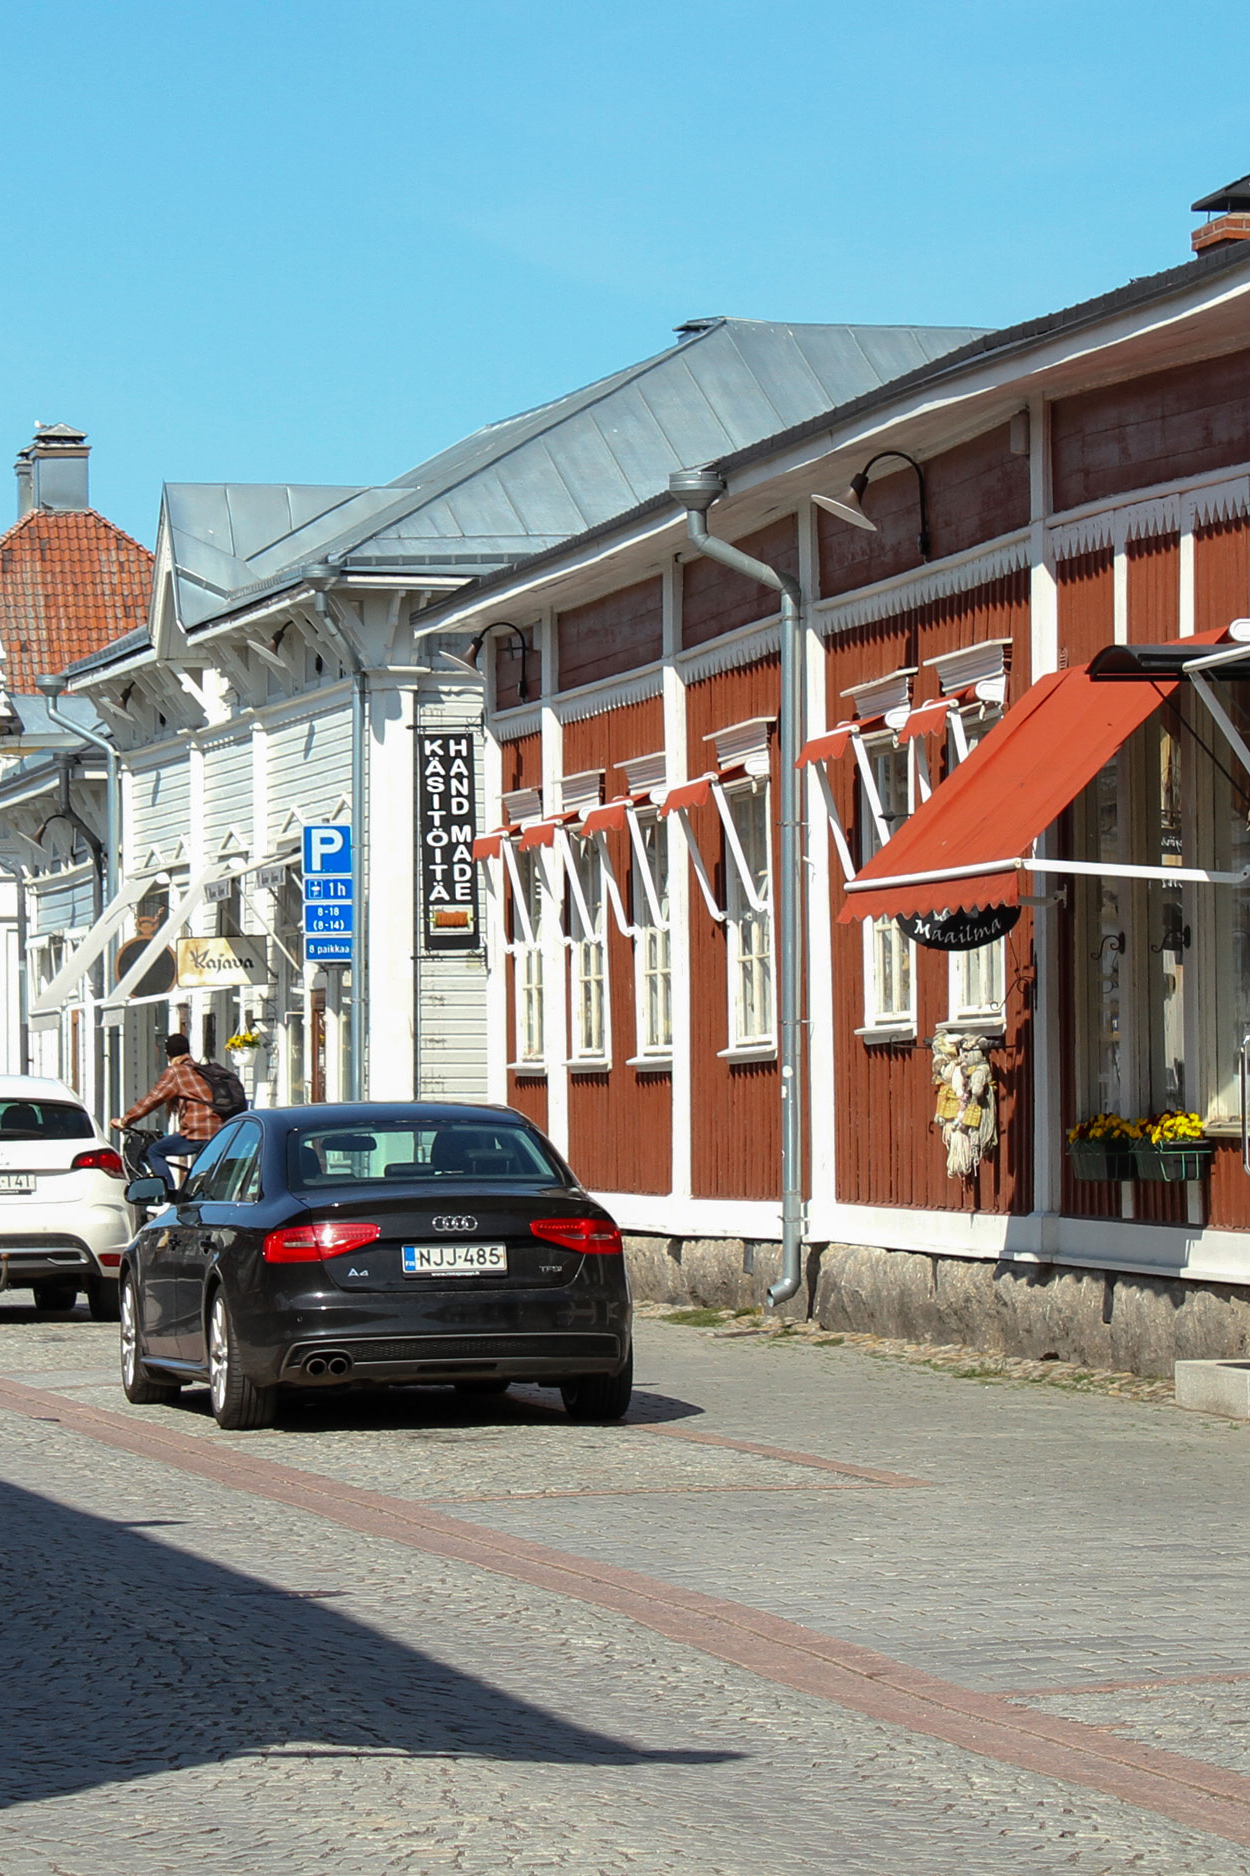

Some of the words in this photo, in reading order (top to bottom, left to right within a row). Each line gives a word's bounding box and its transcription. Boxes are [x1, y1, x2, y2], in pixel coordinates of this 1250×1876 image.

[449, 739, 469, 816] HAND
[424, 739, 449, 901] KÄSITÖITÄ
[311, 828, 344, 872] P
[451, 825, 472, 901] MADE
[312, 919, 345, 931] (8-14)
[317, 907, 340, 917] 8-18
[914, 917, 1001, 944] Maailma
[308, 944, 315, 954] 8
[317, 944, 351, 955] paikkaa
[418, 1247, 500, 1267] NJJ-485
